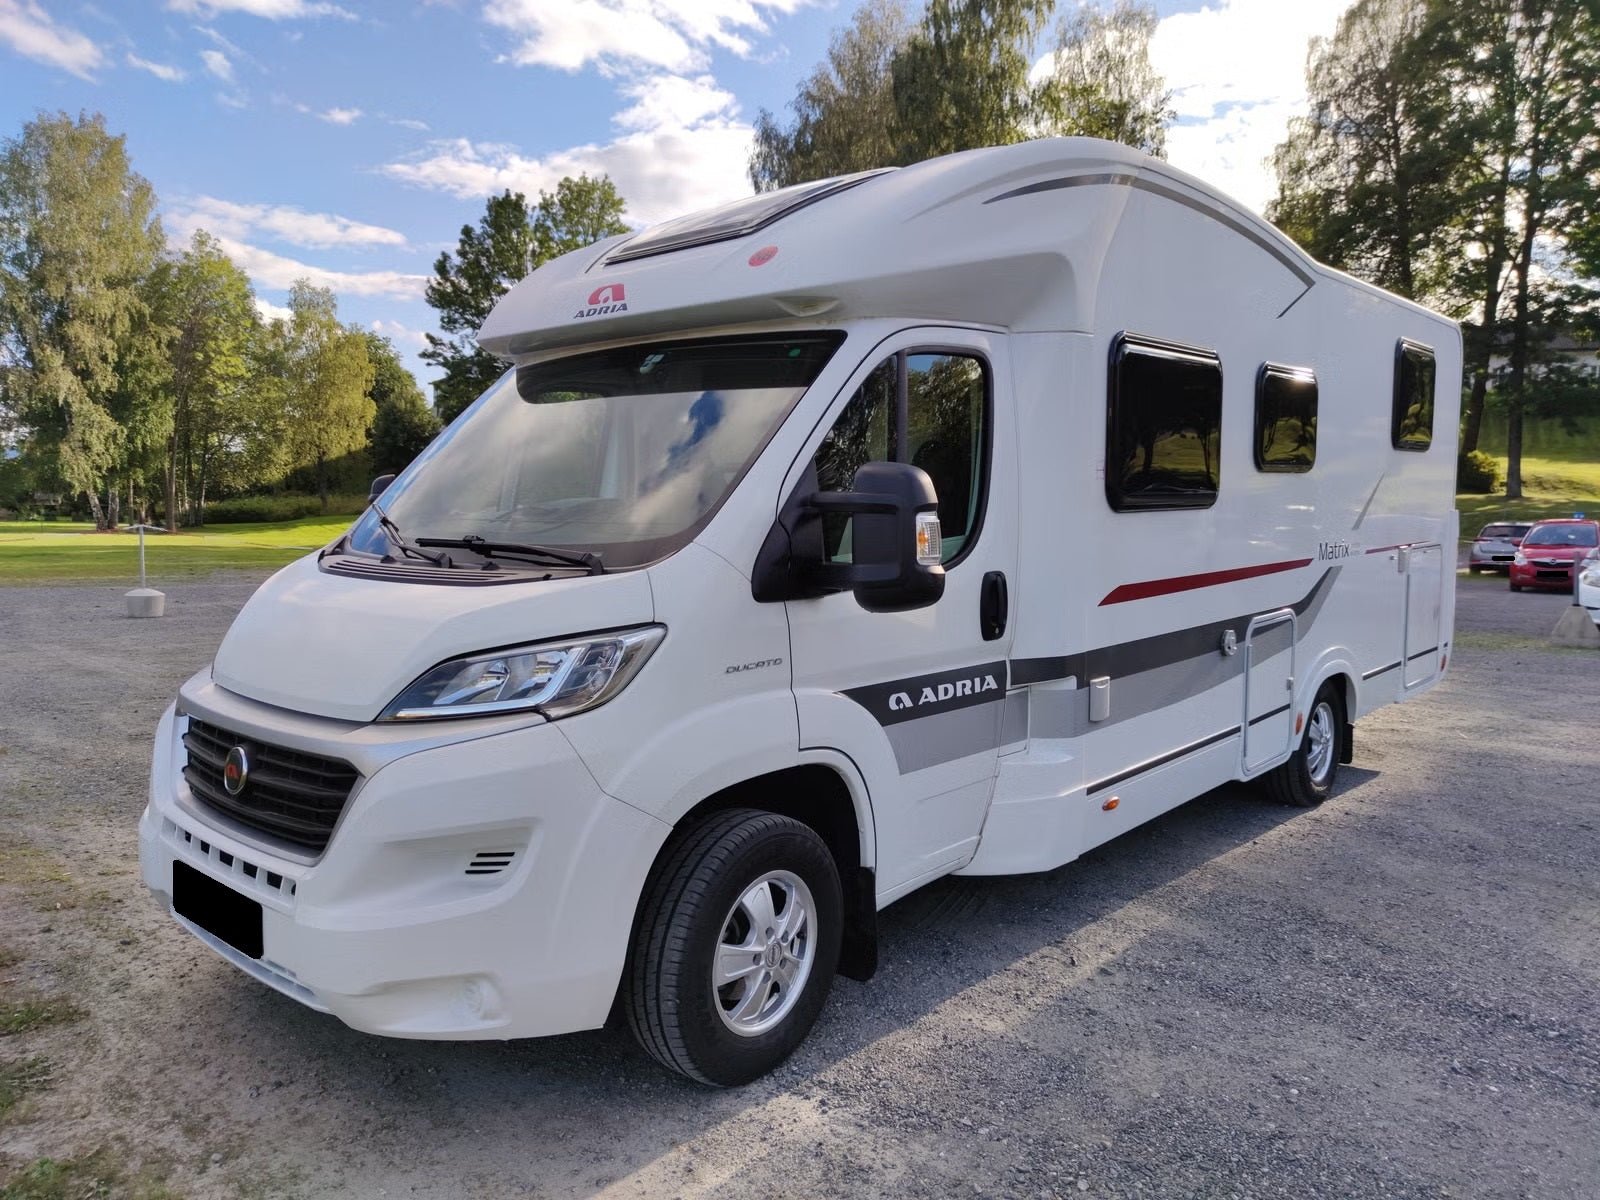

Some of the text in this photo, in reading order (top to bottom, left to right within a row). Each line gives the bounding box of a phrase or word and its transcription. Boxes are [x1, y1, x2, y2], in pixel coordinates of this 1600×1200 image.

[573, 303, 628, 319] ADRIA
[1319, 541, 1350, 561] Matrix
[725, 657, 783, 674] DUCATO
[918, 675, 998, 705] ADRIA
